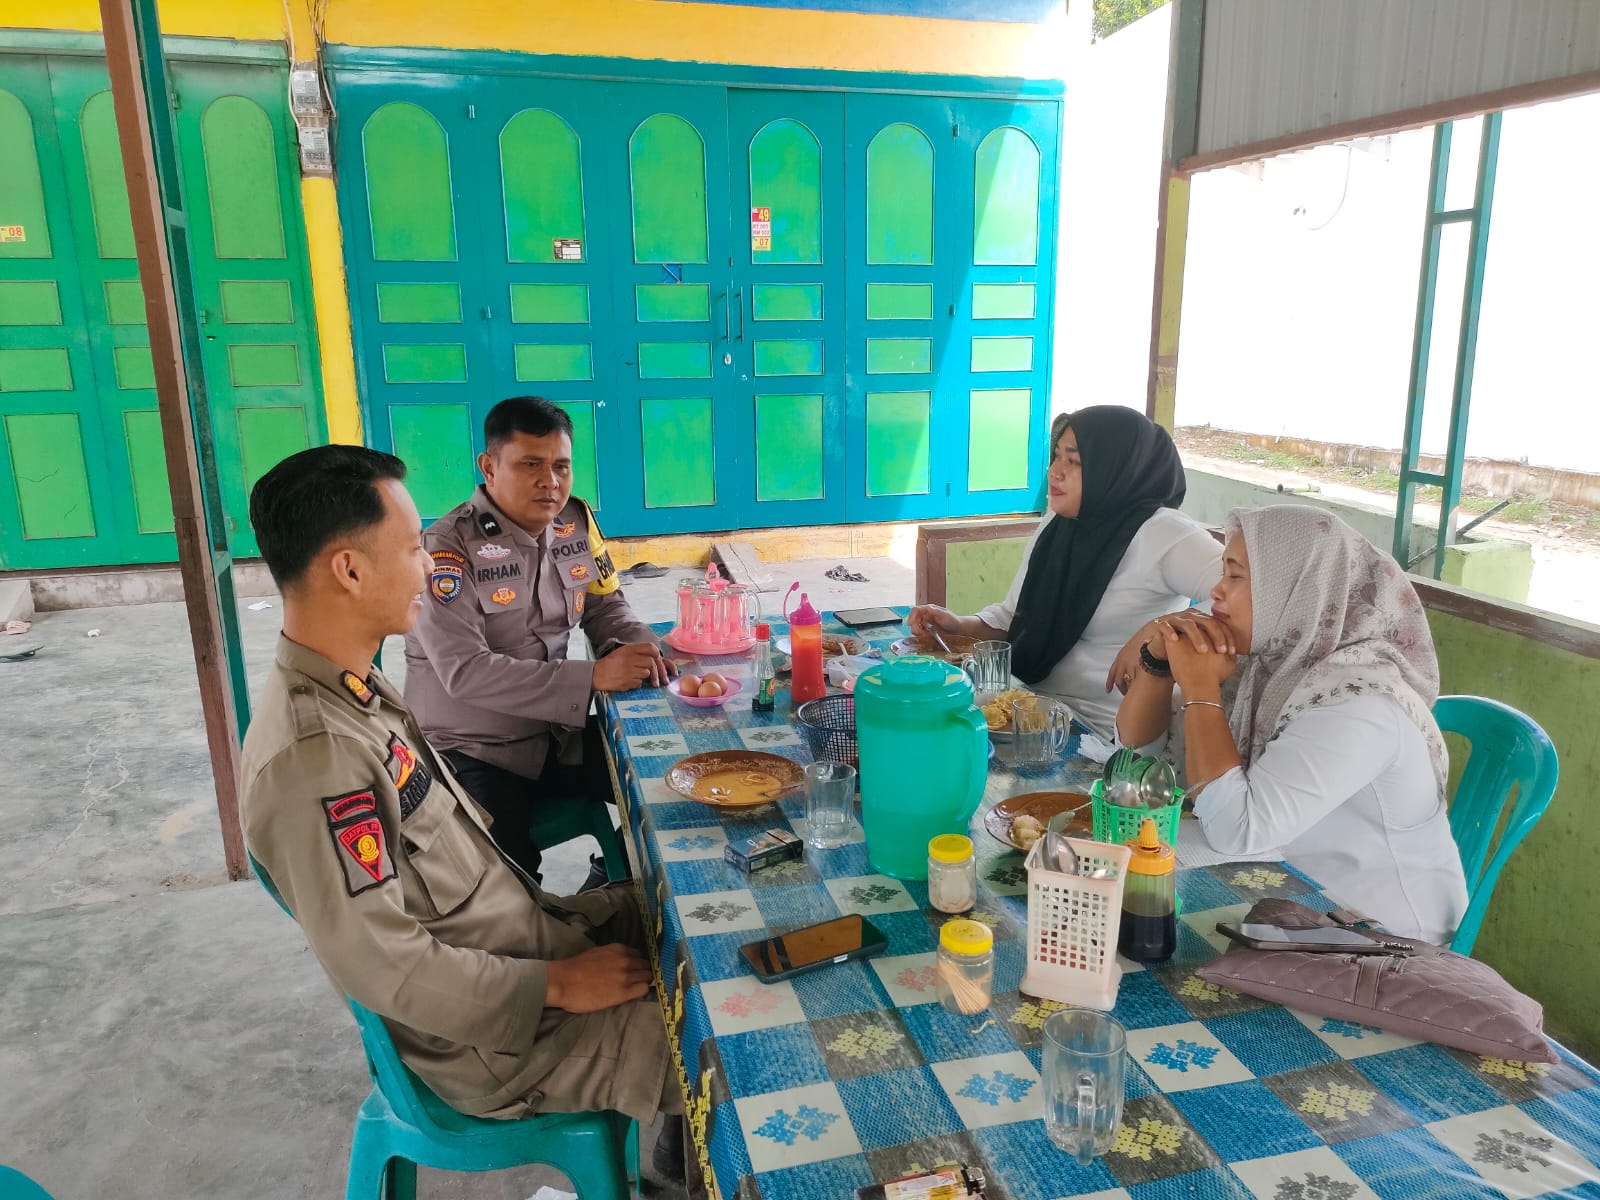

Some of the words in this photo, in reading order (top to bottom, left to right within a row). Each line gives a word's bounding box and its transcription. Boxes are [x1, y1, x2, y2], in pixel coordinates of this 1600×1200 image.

[759, 209, 769, 221] 49
[9, 227, 22, 236] 08
[760, 238, 769, 246] 07
[551, 539, 589, 560] POLRI
[477, 562, 521, 583] IRHAM
[343, 823, 369, 842] SATPOL
